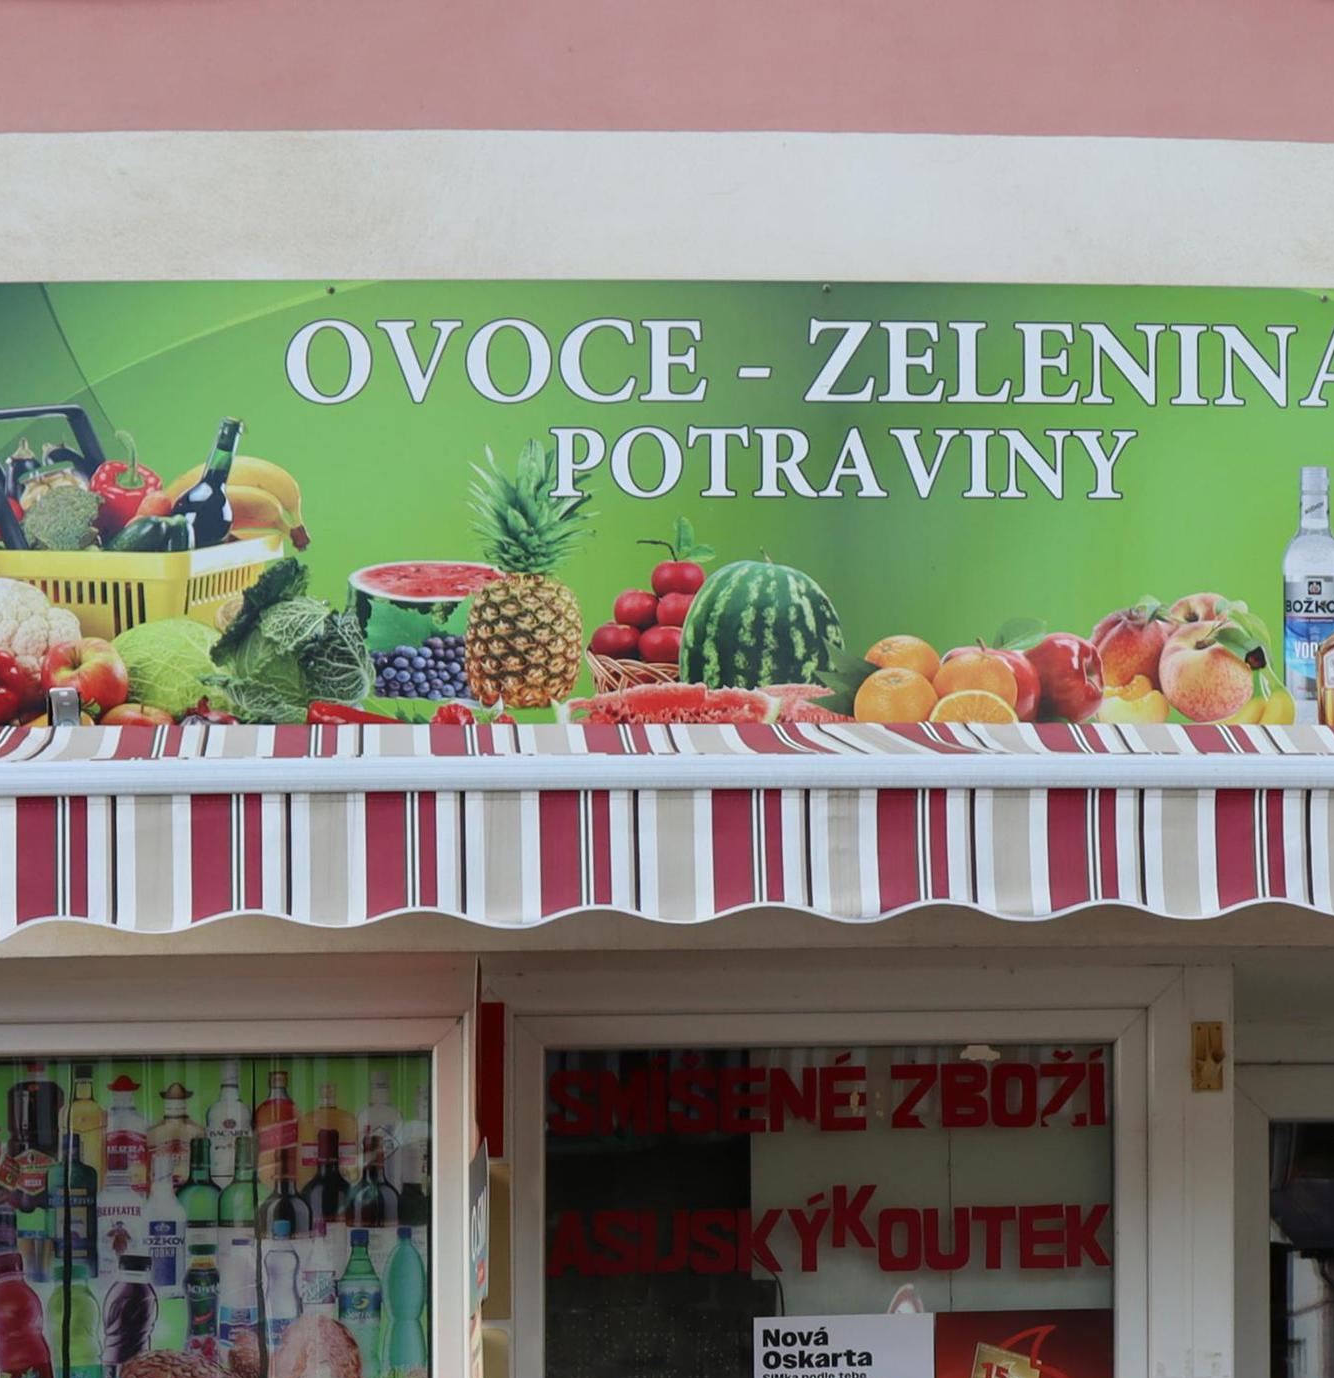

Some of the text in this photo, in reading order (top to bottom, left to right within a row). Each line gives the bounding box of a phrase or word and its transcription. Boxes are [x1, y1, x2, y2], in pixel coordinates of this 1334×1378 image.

[284, 318, 709, 404] OVOCE
[549, 425, 1139, 501] POTRAVINY
[548, 1047, 1106, 1134] SMÍŠENÉ ZBOŽÍ
[97, 1206, 141, 1217] BEEFEATER
[831, 1184, 1111, 1272] KOUTEK
[762, 1327, 829, 1348] Nová
[762, 1350, 874, 1370] Oskarta
